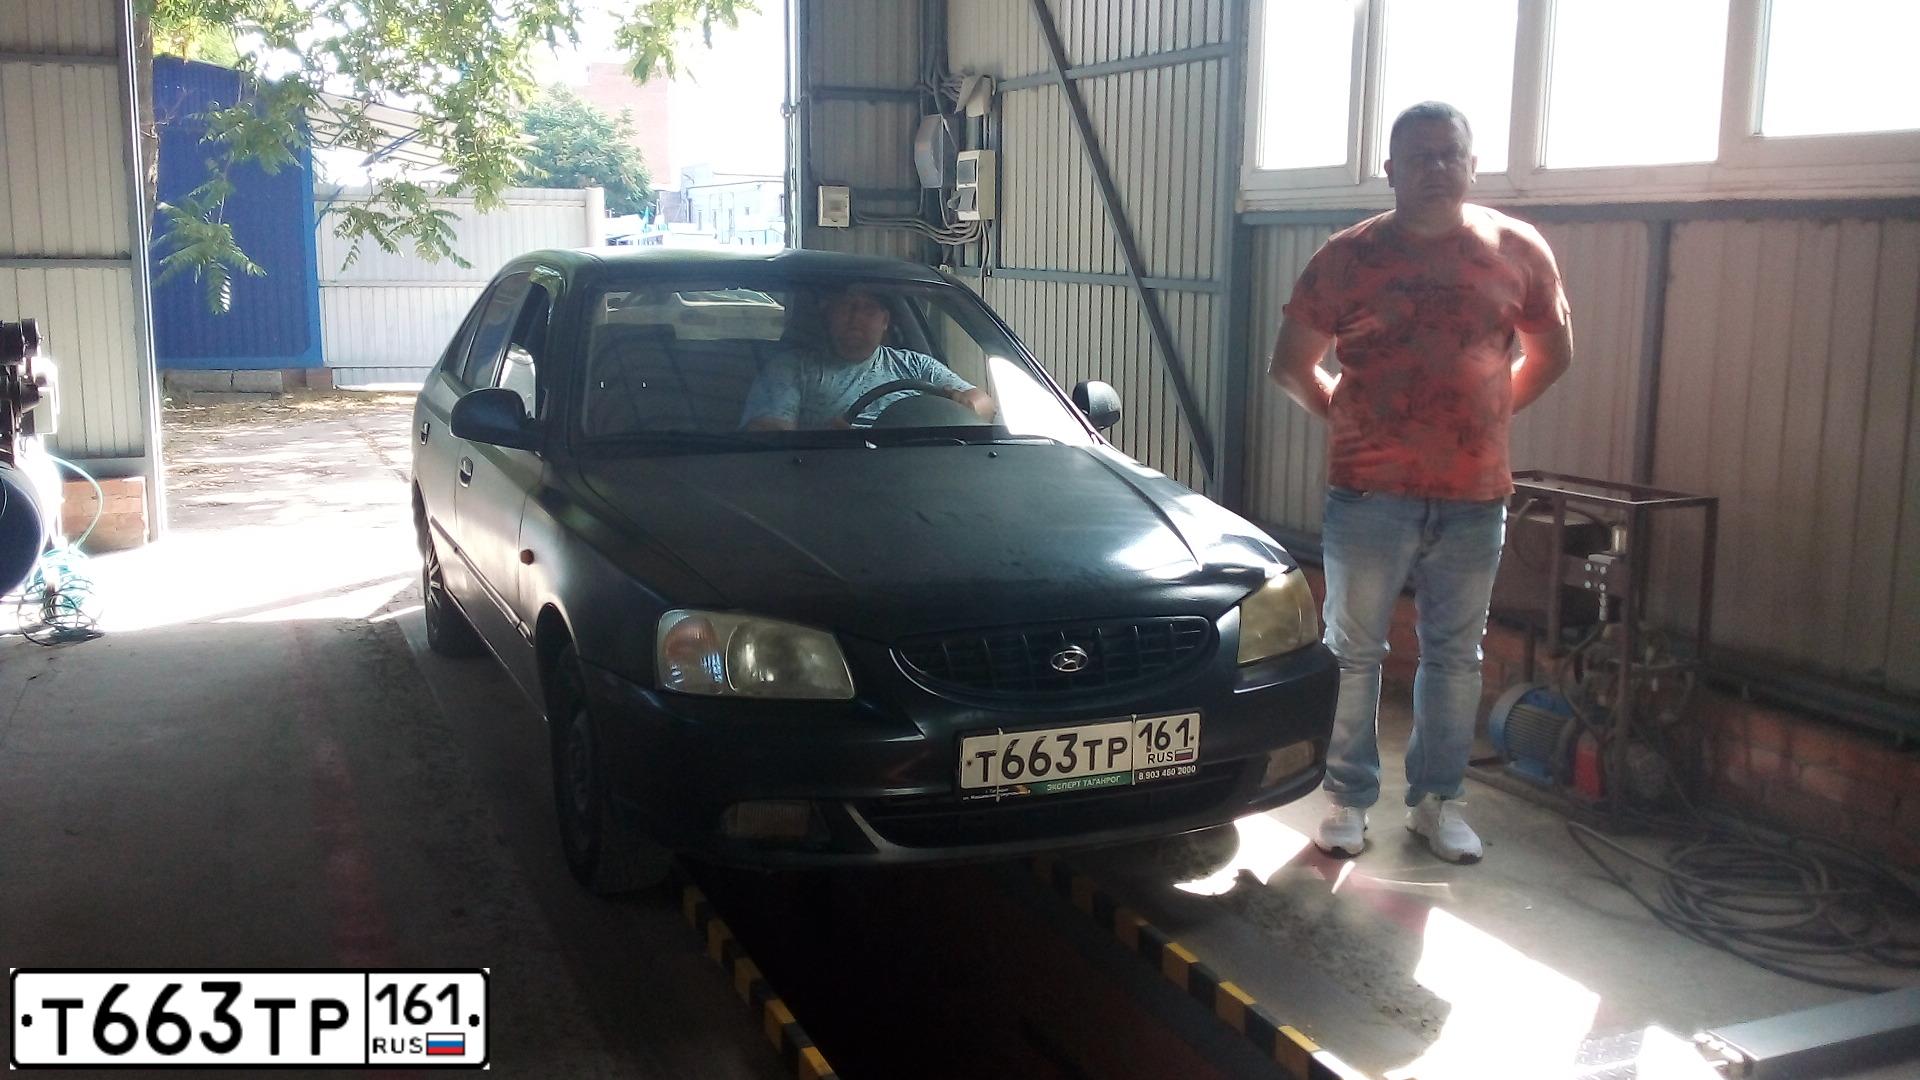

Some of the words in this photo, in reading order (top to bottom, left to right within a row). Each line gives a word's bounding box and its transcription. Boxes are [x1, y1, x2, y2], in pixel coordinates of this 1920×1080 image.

[1138, 718, 1190, 752] 161
[1147, 752, 1174, 764] RUS
[1145, 770, 1160, 778] 903
[1046, 780, 1081, 792] ЭКСПЕРТ
[1083, 774, 1120, 787] ТАГАНРОГ
